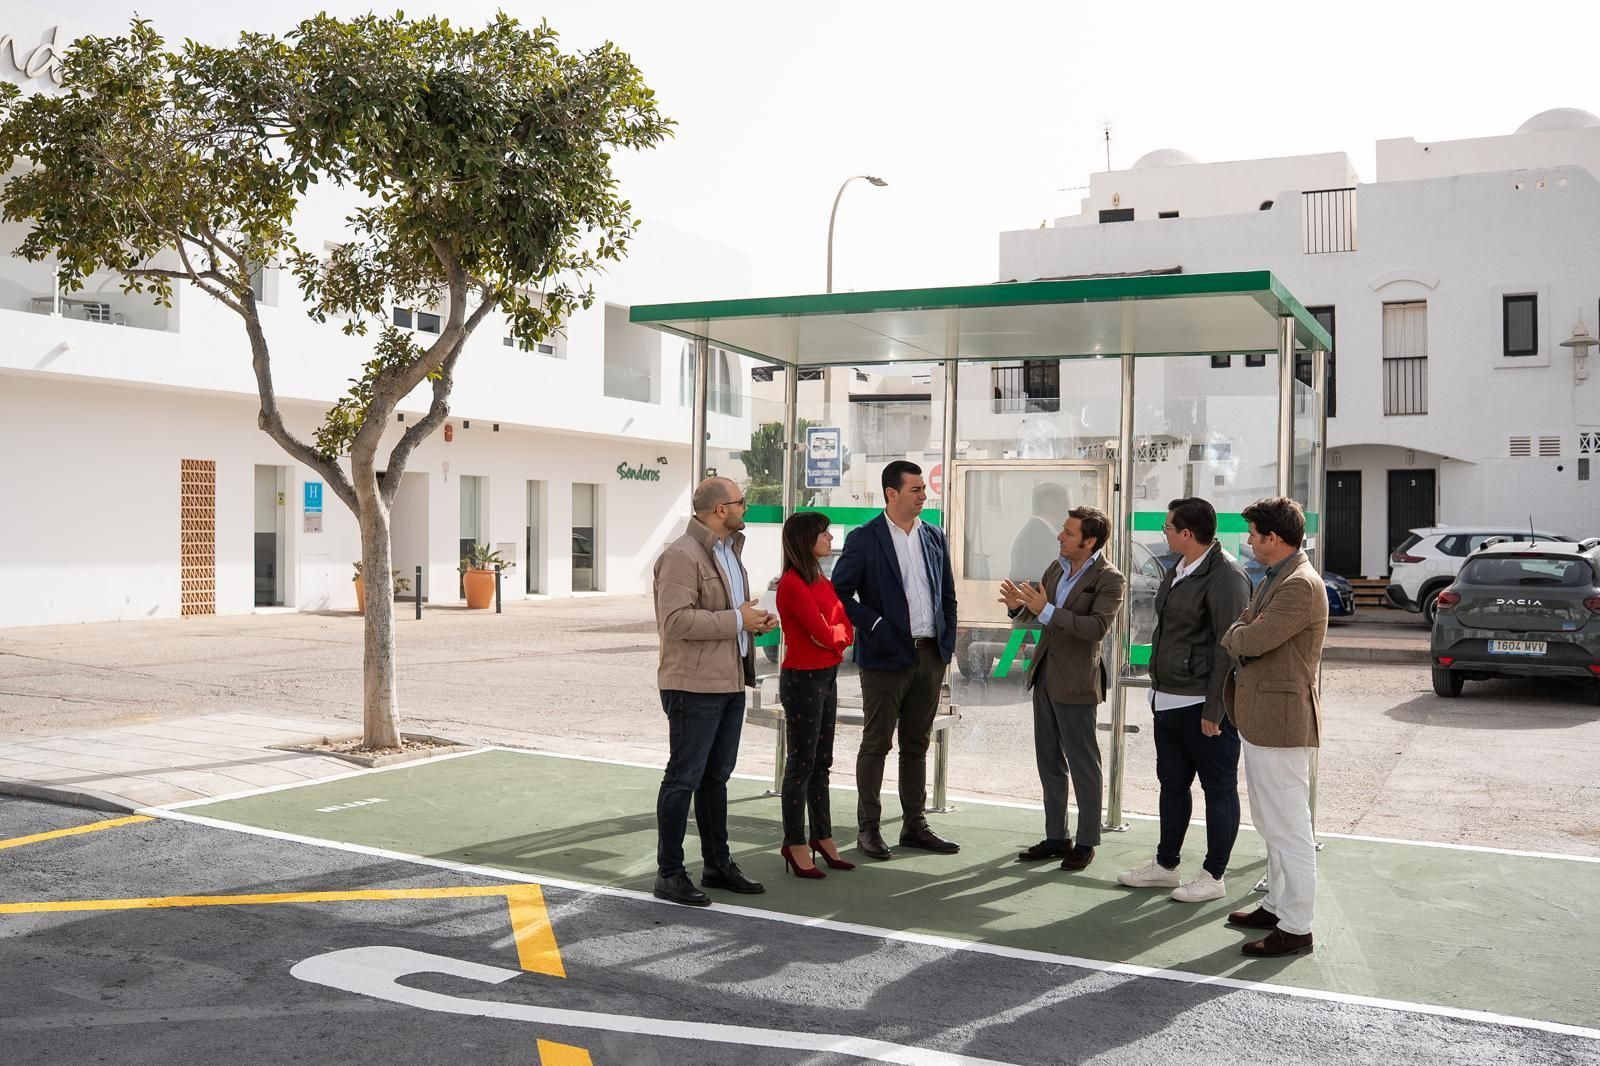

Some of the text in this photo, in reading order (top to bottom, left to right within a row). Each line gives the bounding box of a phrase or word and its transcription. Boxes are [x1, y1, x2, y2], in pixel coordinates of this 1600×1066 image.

[616, 461, 660, 481] Senderos
[1337, 480, 1343, 488] 2
[310, 485, 318, 498] H
[1496, 598, 1542, 606] DACIA
[1497, 641, 1545, 652] 1604 MVV
